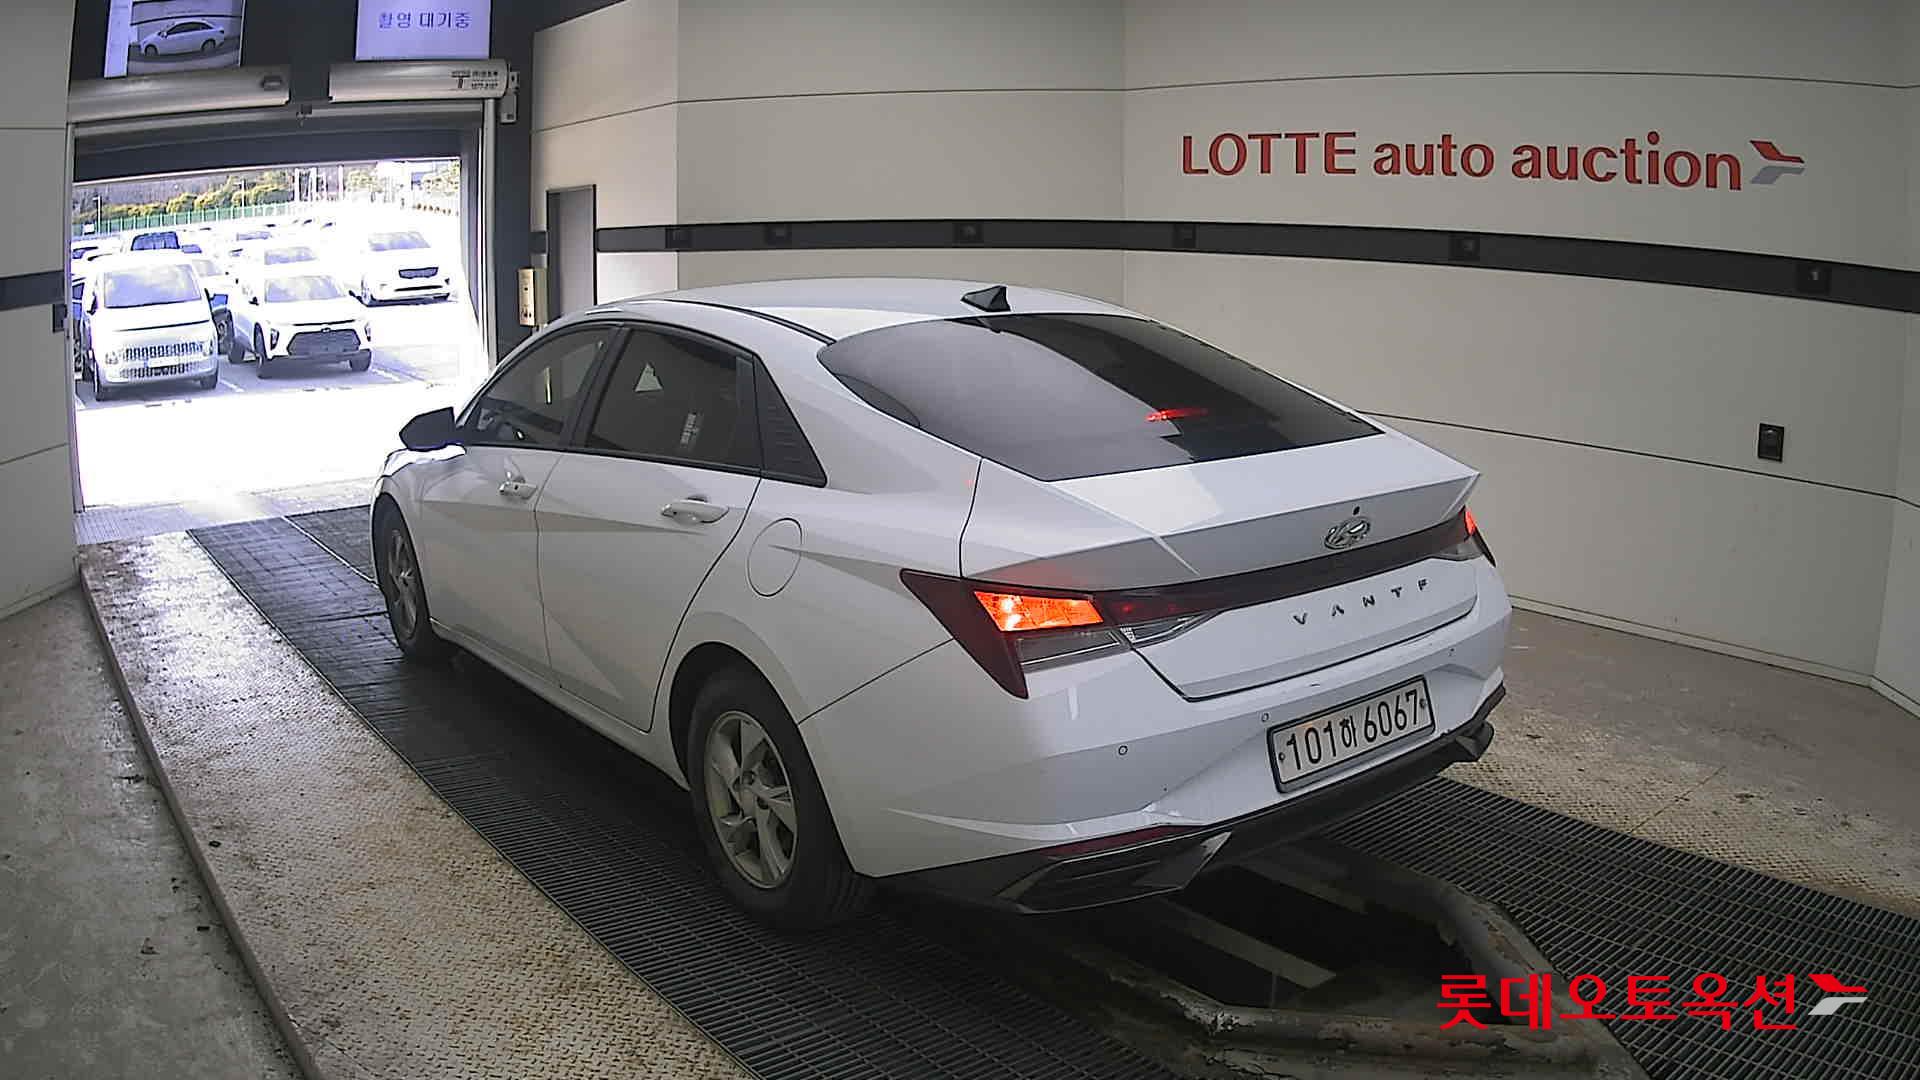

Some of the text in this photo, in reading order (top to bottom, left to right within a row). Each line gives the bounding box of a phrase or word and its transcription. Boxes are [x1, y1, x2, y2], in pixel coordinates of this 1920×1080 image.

[419, 12, 472, 29] 대기중
[1182, 131, 1742, 190] LOTTE auto auction
[1363, 688, 1418, 743] 6067
